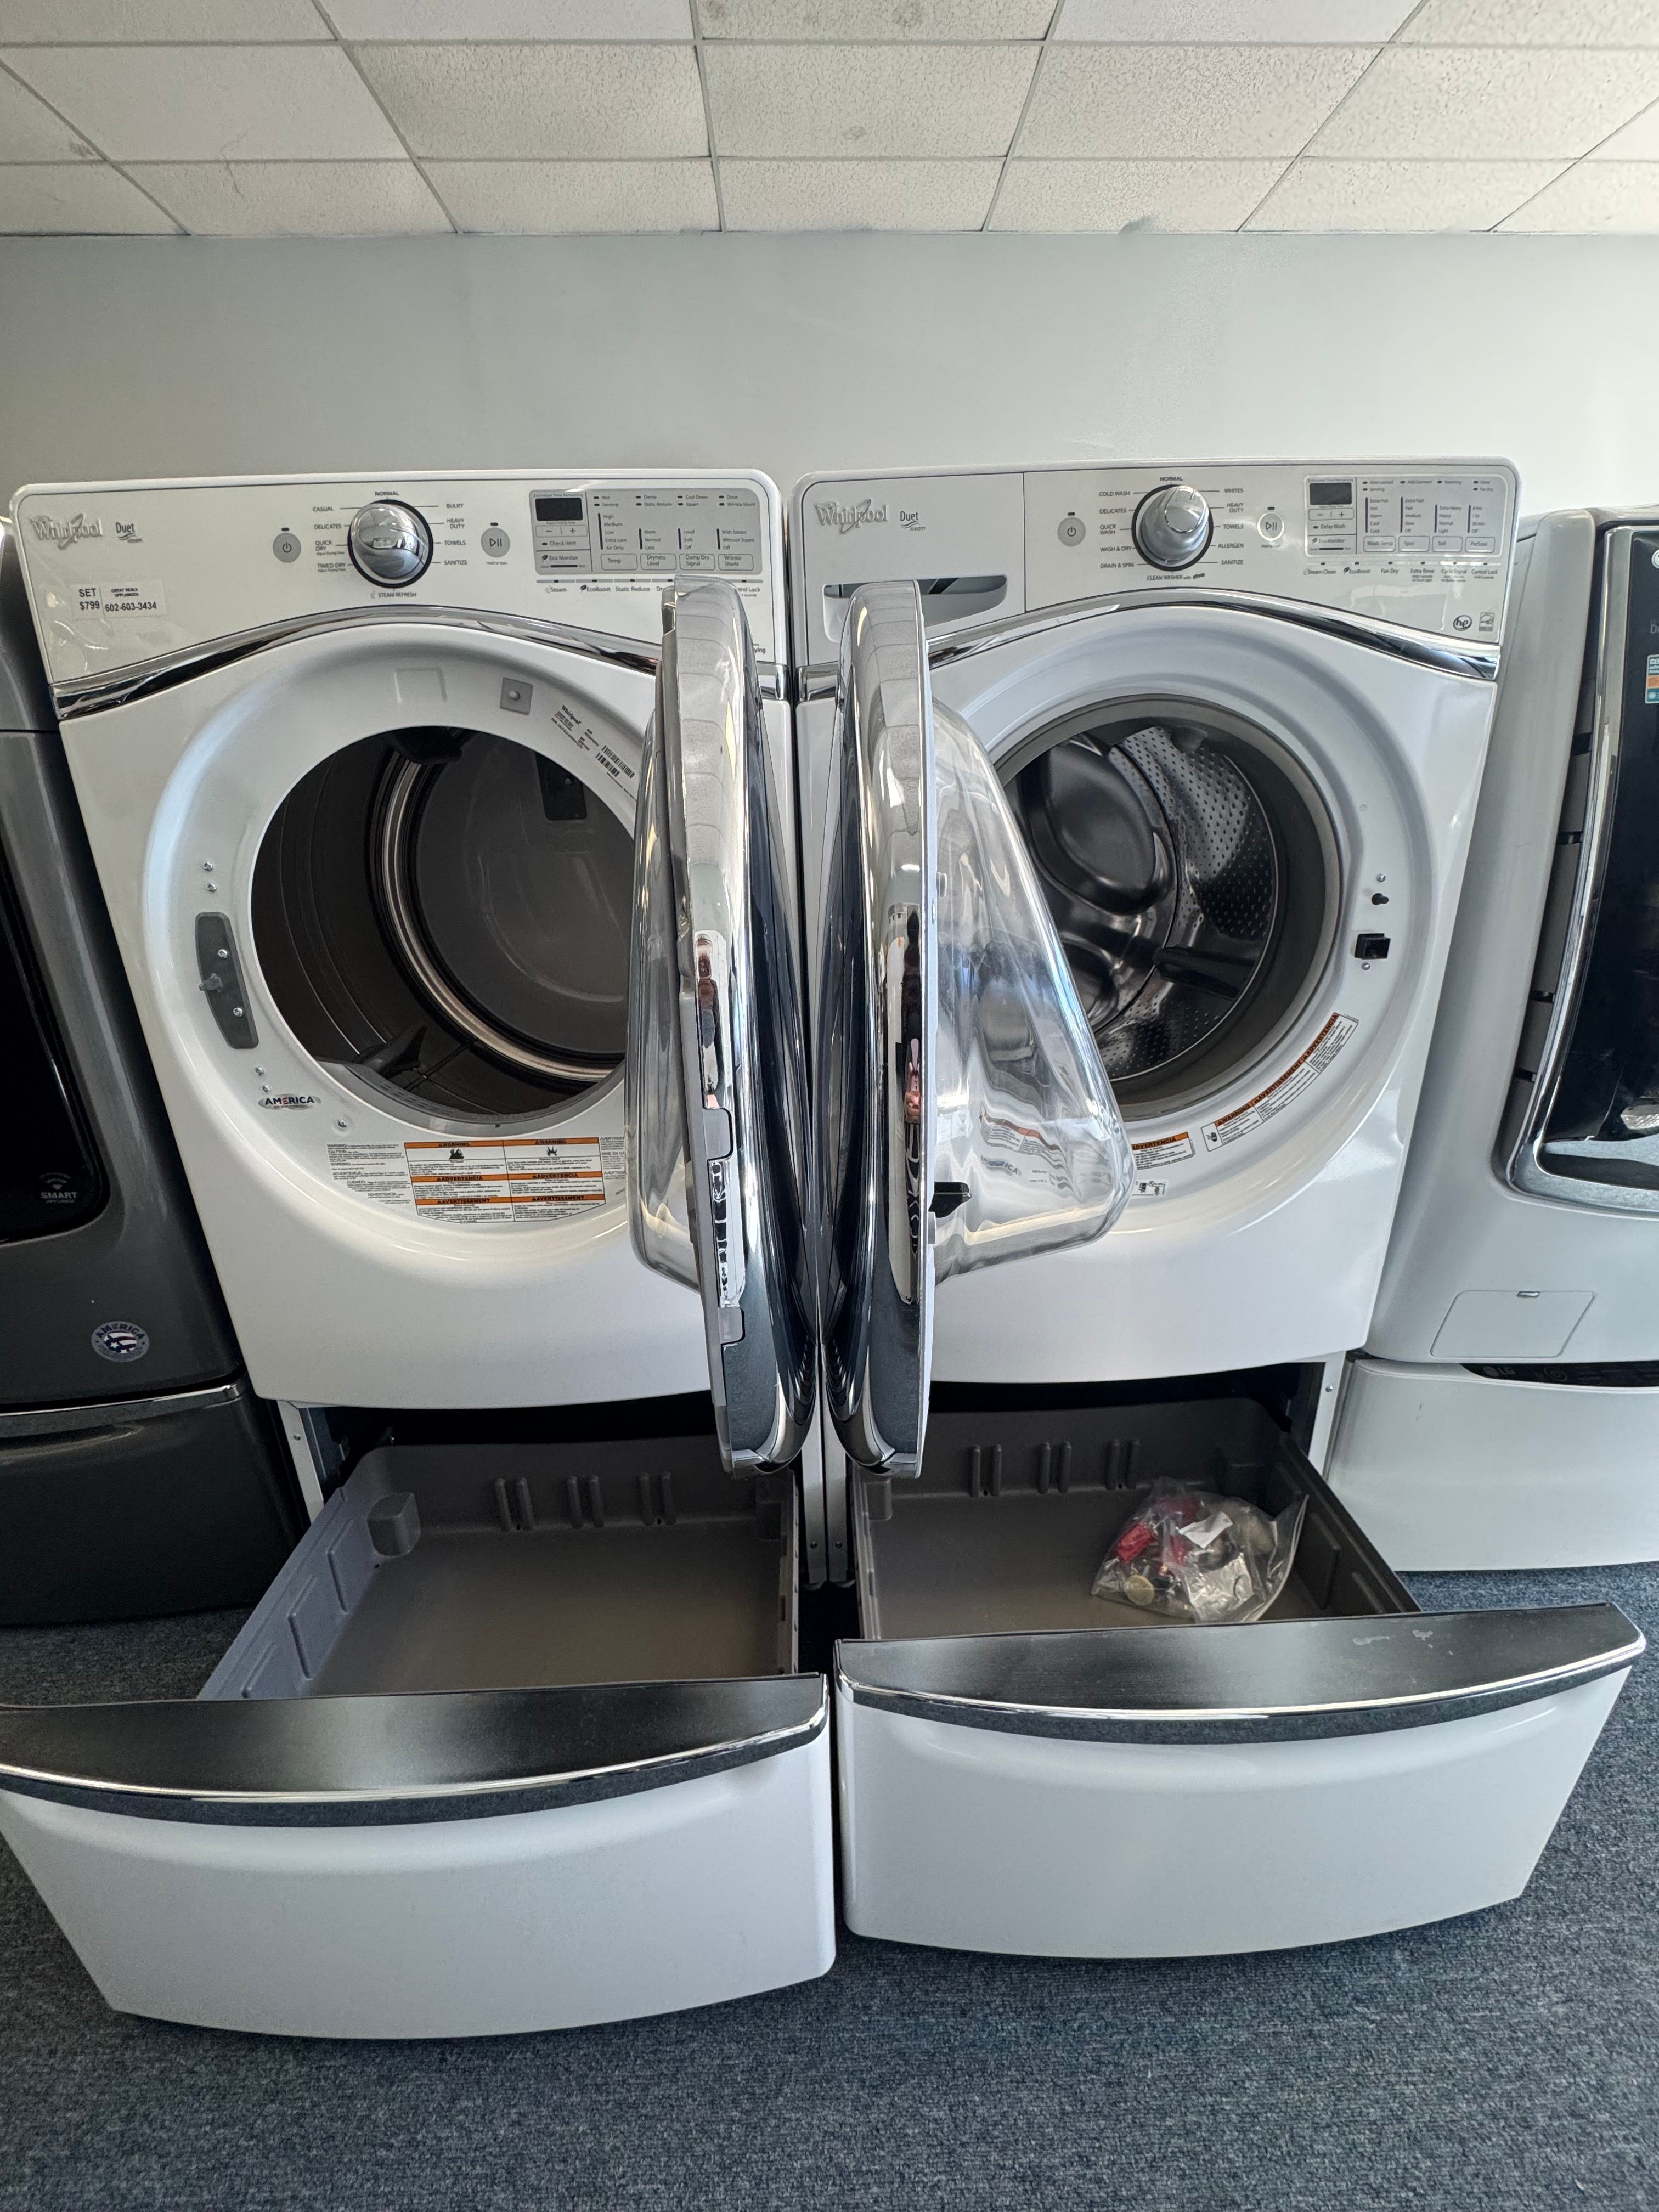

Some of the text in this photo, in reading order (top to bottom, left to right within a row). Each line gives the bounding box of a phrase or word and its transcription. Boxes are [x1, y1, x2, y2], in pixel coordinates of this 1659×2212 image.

[814, 499, 888, 534] Whirlpool
[900, 511, 919, 522] Duet
[31, 514, 103, 550] Whirlpool
[116, 522, 136, 533] Duet
[79, 588, 97, 597] SET
[80, 601, 100, 611] $799
[105, 601, 157, 612] 602-603-3434
[265, 1096, 315, 1105] AMERICA
[1222, 1104, 1250, 1125] WARNING
[95, 1323, 145, 1339] AMERICA
